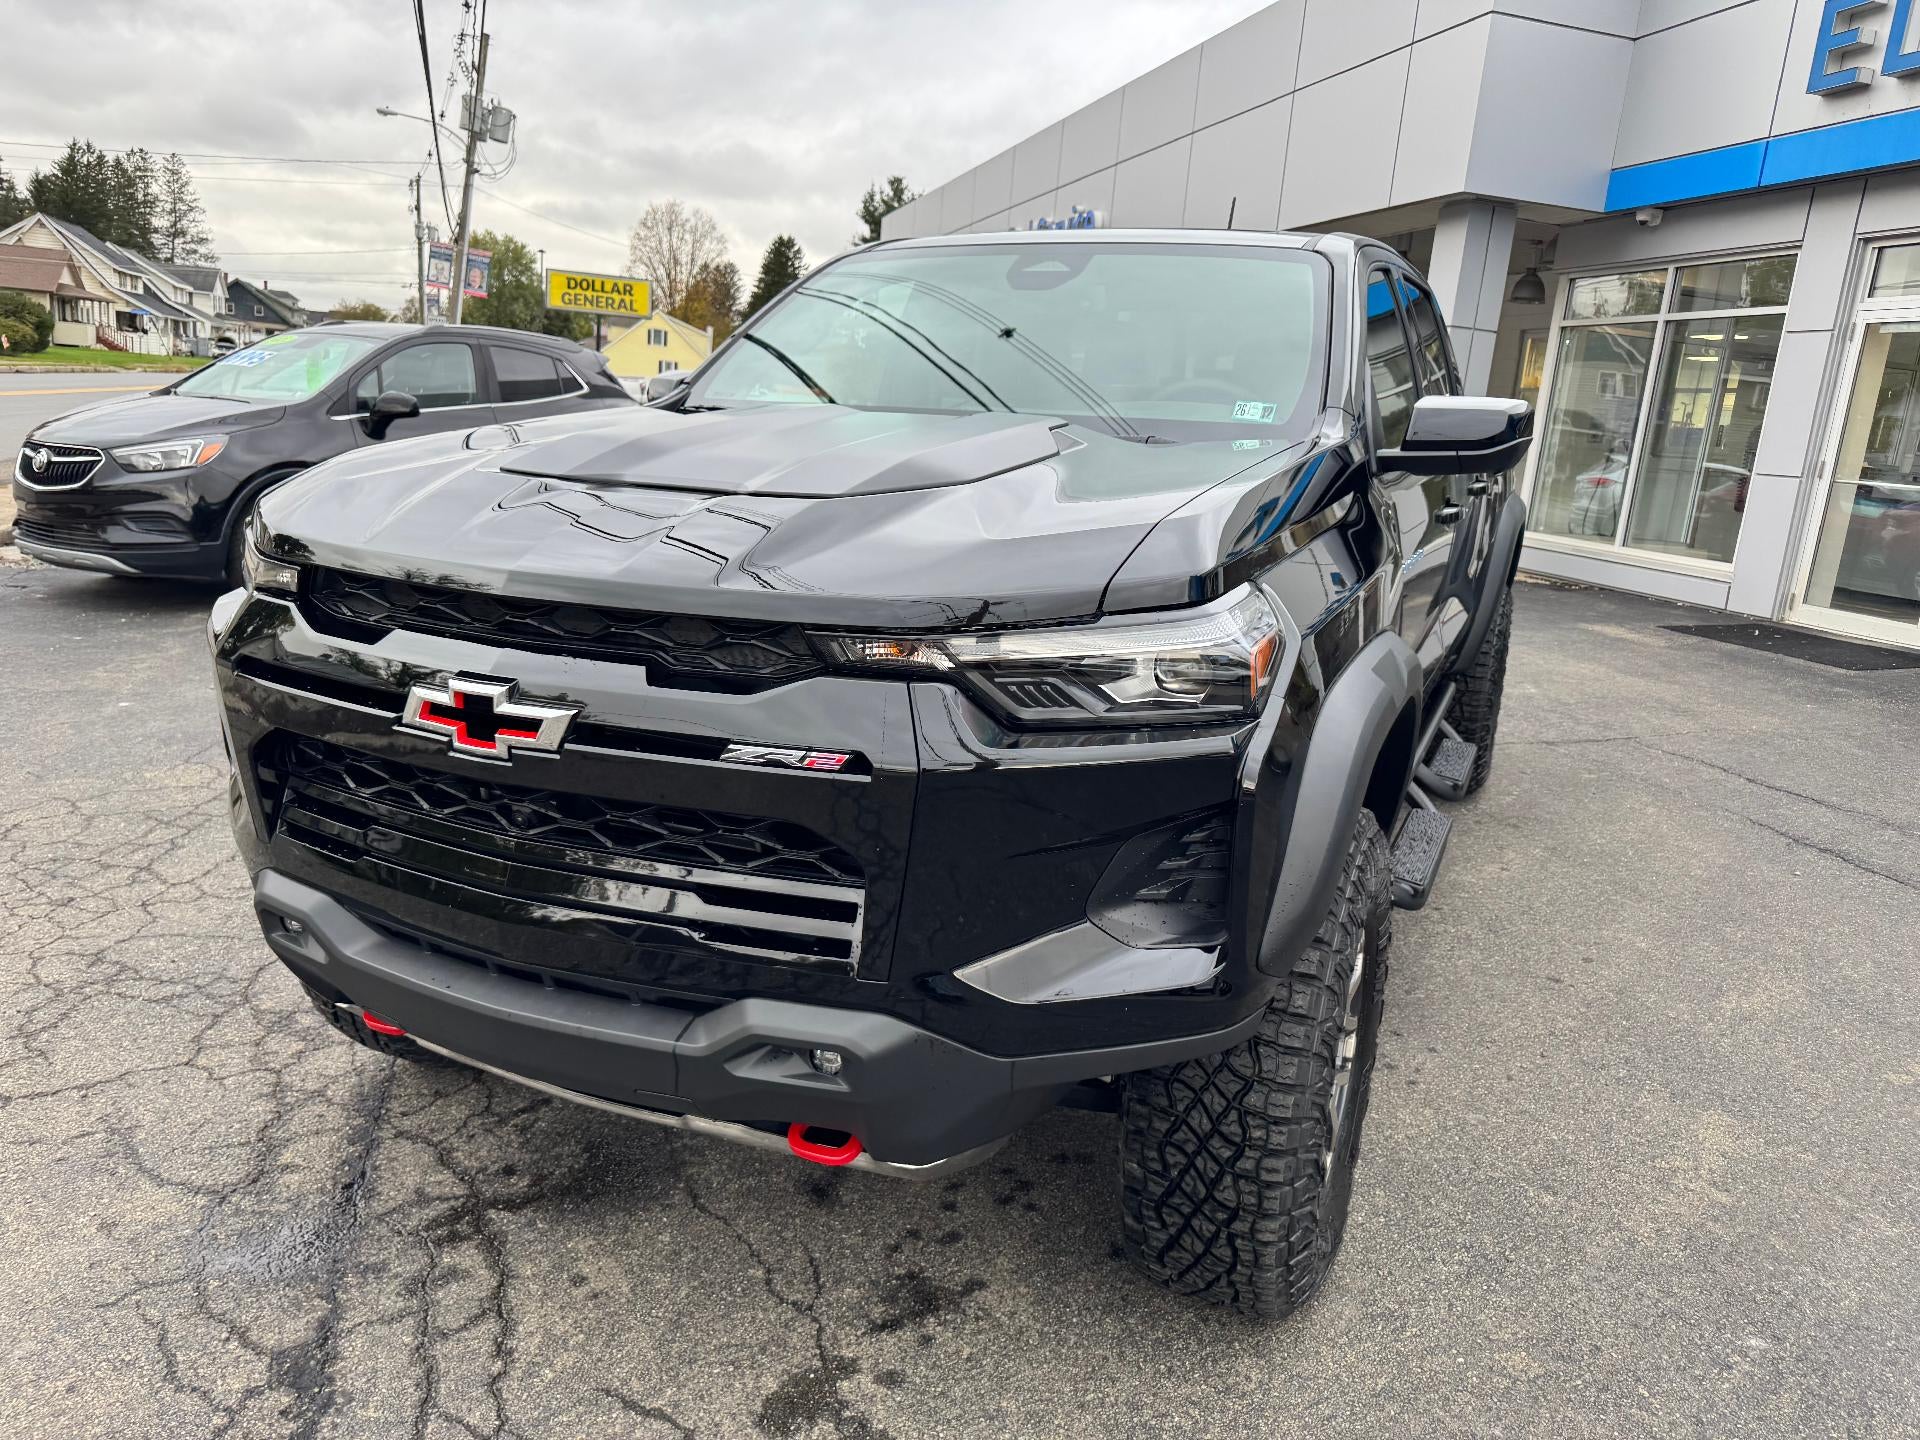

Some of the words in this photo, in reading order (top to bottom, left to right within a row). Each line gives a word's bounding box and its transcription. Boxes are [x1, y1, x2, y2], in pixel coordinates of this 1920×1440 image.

[566, 276, 634, 297] DOLLAR
[561, 291, 639, 313] GENERAL
[720, 743, 850, 770] ZR2
